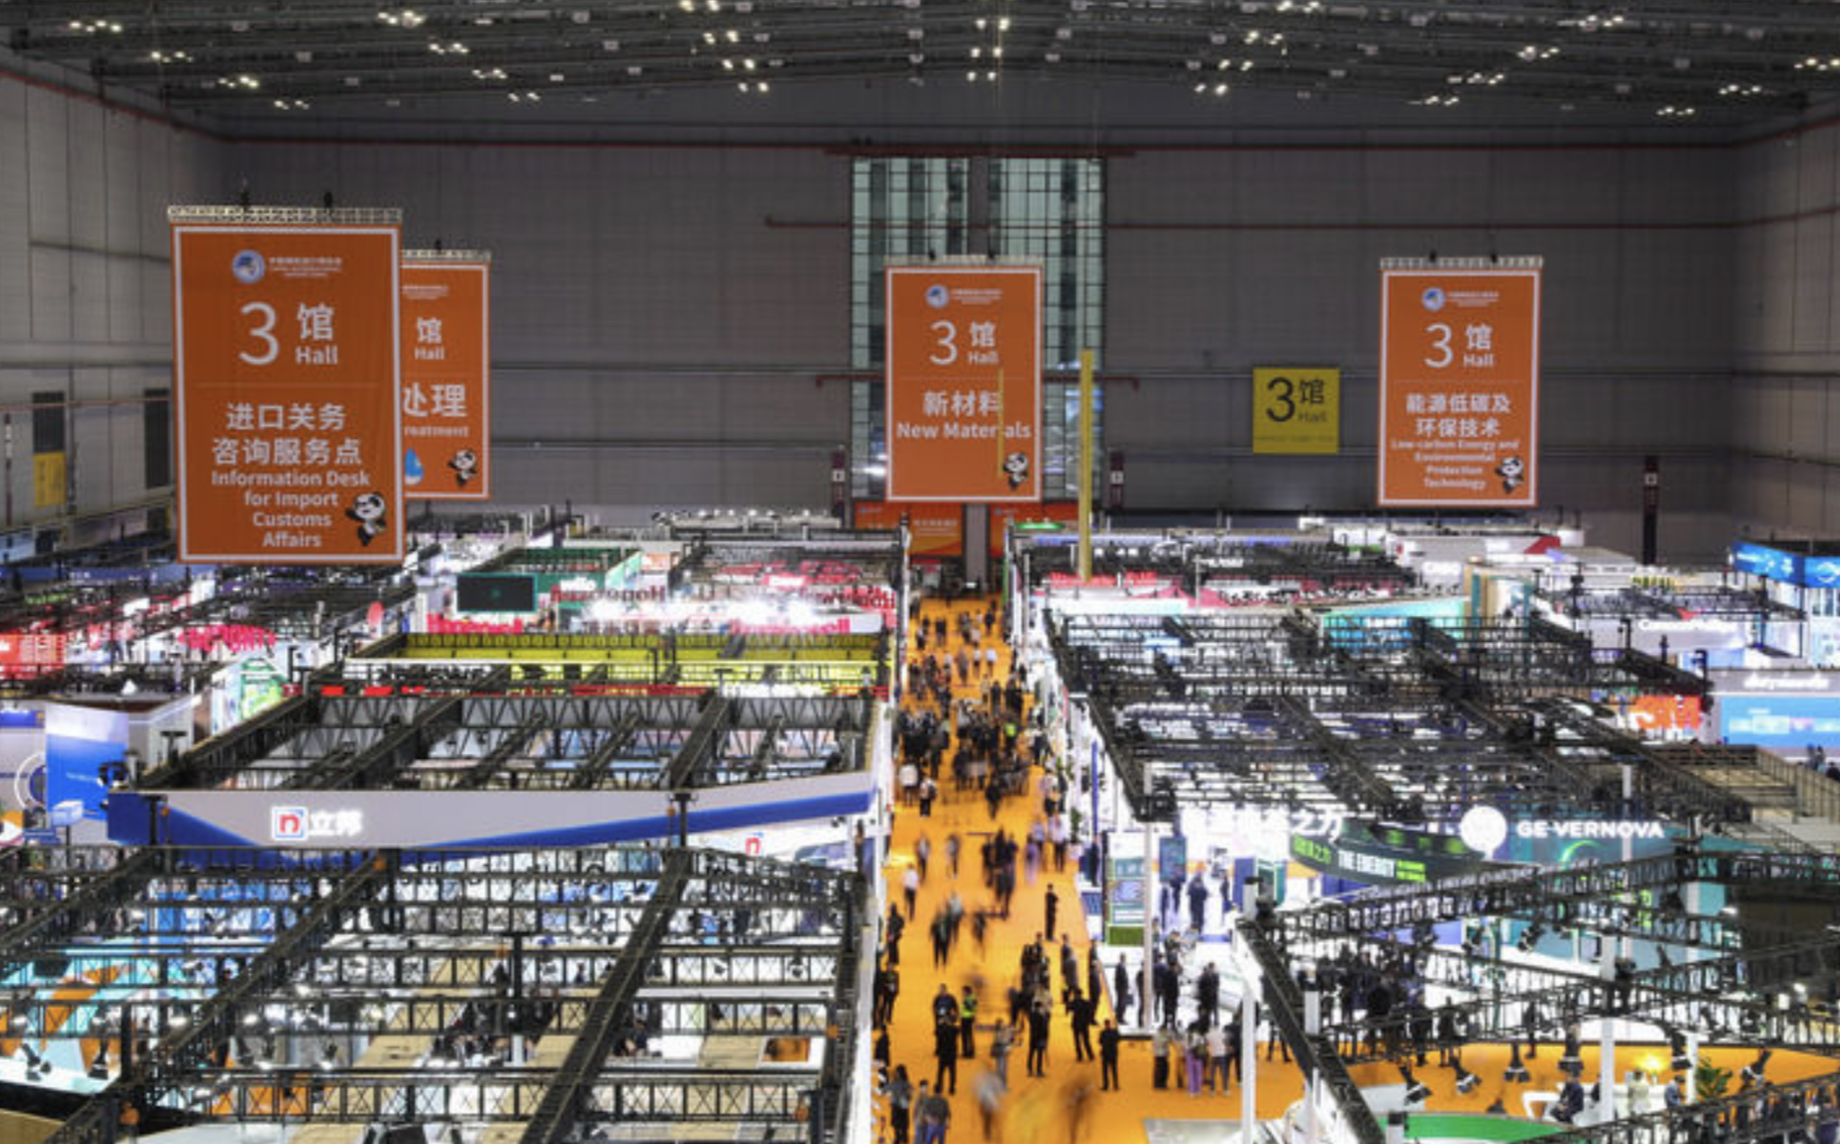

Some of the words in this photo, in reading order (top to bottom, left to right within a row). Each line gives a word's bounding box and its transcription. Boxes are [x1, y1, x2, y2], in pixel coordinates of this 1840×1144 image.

[238, 302, 279, 365] 3
[297, 302, 335, 340] 馆
[416, 317, 442, 344] 馆
[929, 320, 959, 365] 3
[968, 320, 996, 347] 馆
[1424, 323, 1453, 368] 3
[1465, 322, 1493, 350] 馆
[295, 345, 338, 365] Hall
[414, 347, 445, 360] Hall
[967, 351, 999, 365] Hall
[1462, 353, 1494, 368] Hall
[403, 382, 467, 417] 处理
[922, 389, 1002, 418] 新材料
[1266, 377, 1296, 422] 3
[1298, 377, 1325, 405] 馆
[226, 403, 346, 431] 进口关务
[403, 426, 469, 438] reatment
[896, 421, 939, 439] New
[943, 421, 1031, 439] Materals
[1415, 417, 1501, 438] 环保技术
[211, 437, 362, 466] 咨询服务点
[211, 470, 322, 486] Information
[326, 470, 370, 486] Desk
[244, 490, 271, 506] for
[274, 490, 339, 509] Import
[253, 511, 332, 527] Customs
[262, 531, 322, 547] Affairs
[1516, 819, 1549, 839] GE
[1554, 819, 1666, 839] VERNOVA
